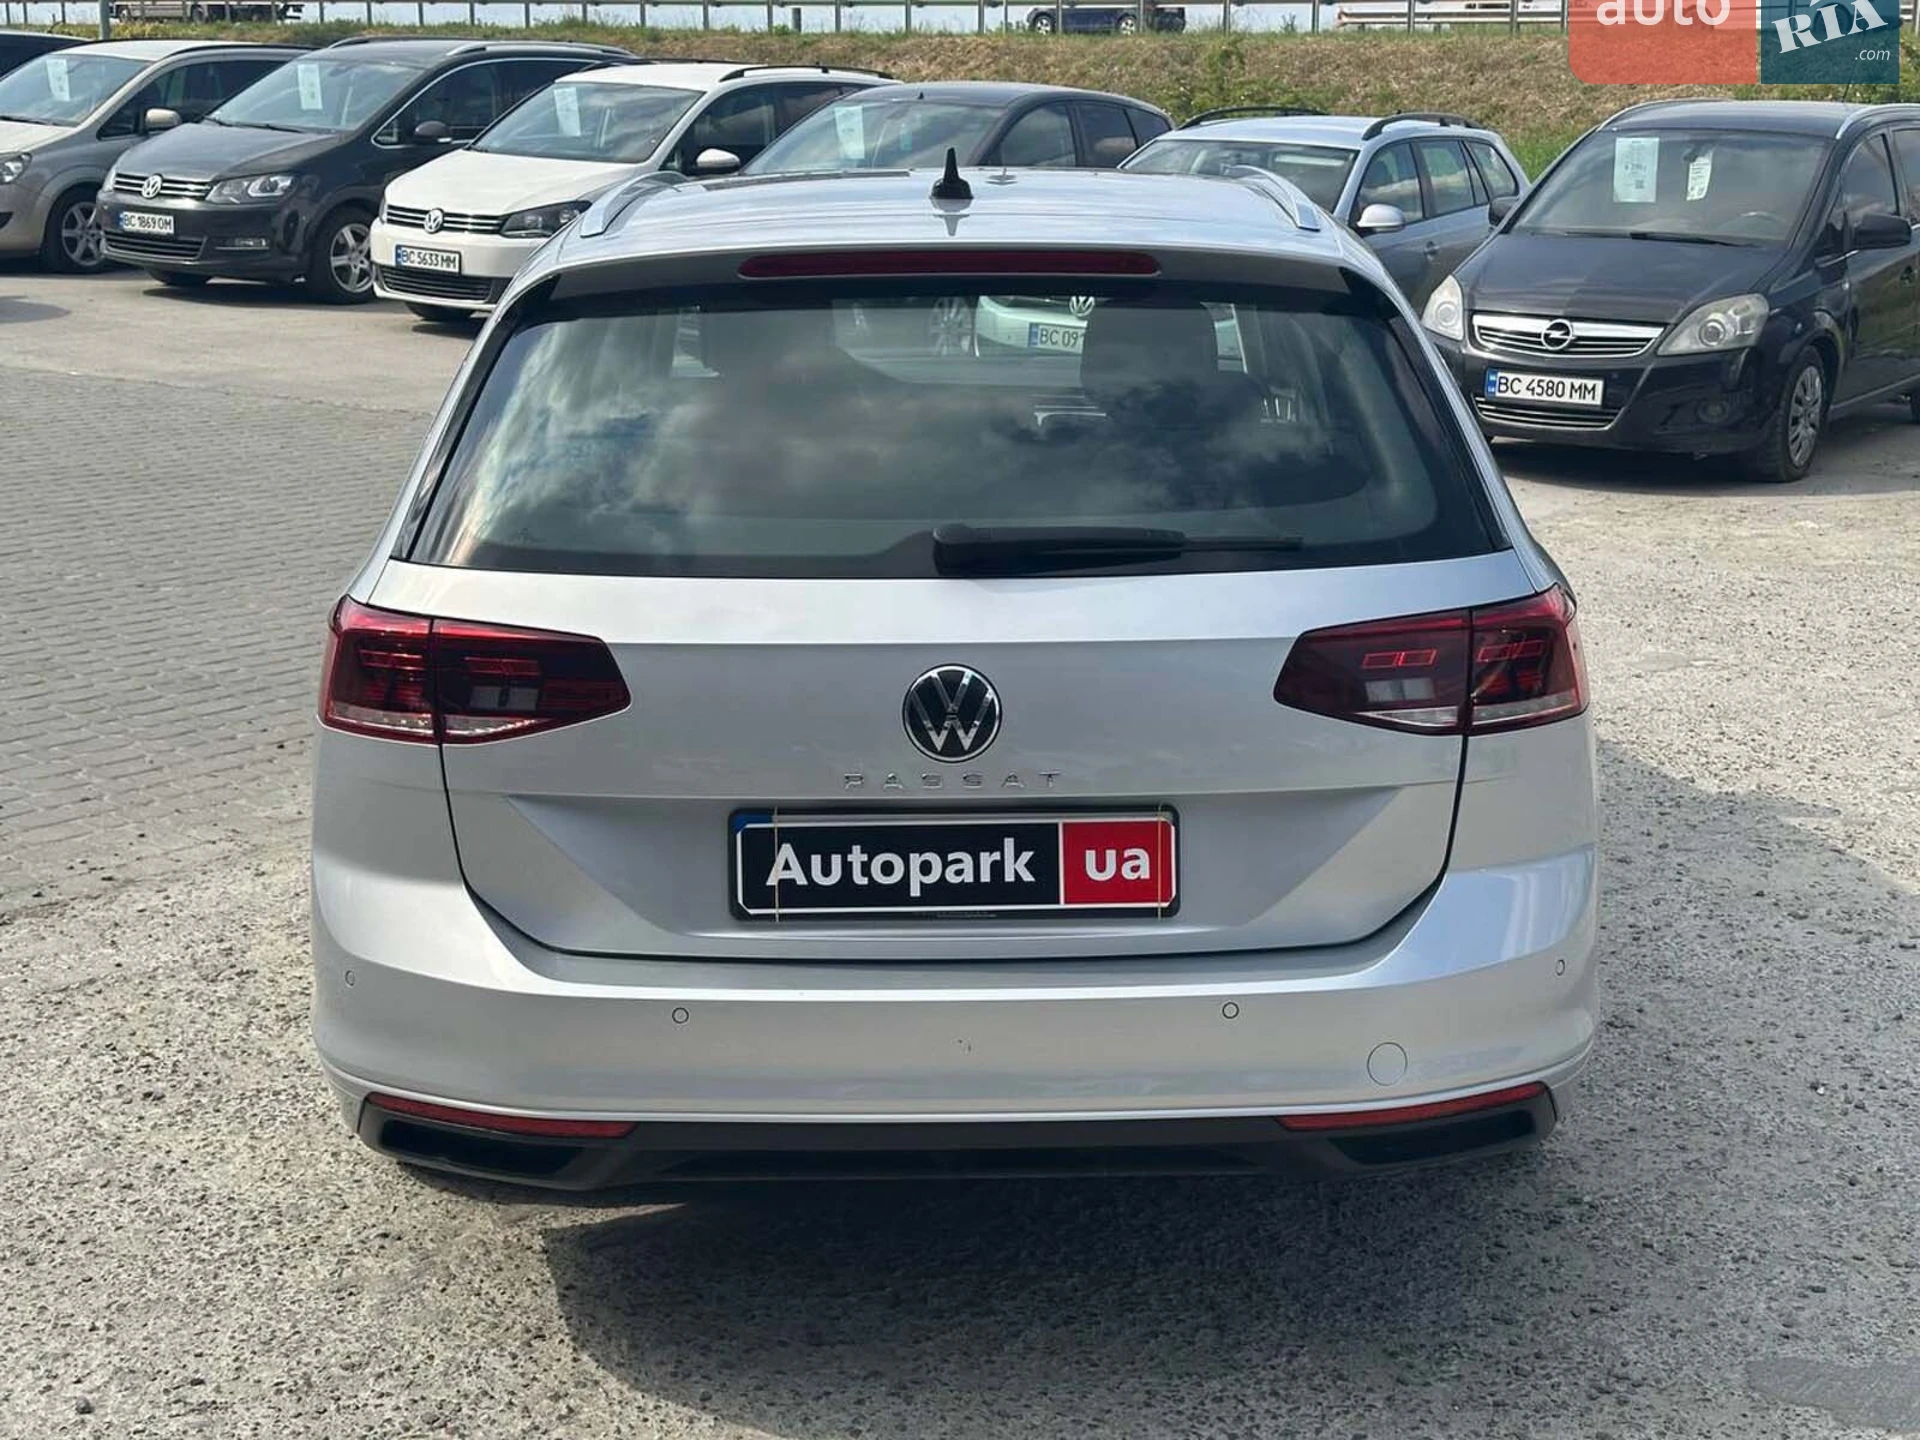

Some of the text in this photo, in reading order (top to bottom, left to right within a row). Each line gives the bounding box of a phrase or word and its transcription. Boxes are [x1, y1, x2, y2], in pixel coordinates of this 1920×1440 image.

[124, 214, 136, 227] BC
[138, 215, 156, 229] 1869
[401, 249, 457, 269] BC 5633 MM
[1040, 328, 1085, 348] BC 09
[1497, 376, 1597, 401] BC 4580 MM
[844, 771, 1062, 790] PASSAT
[766, 837, 1152, 897] Autopark ua
